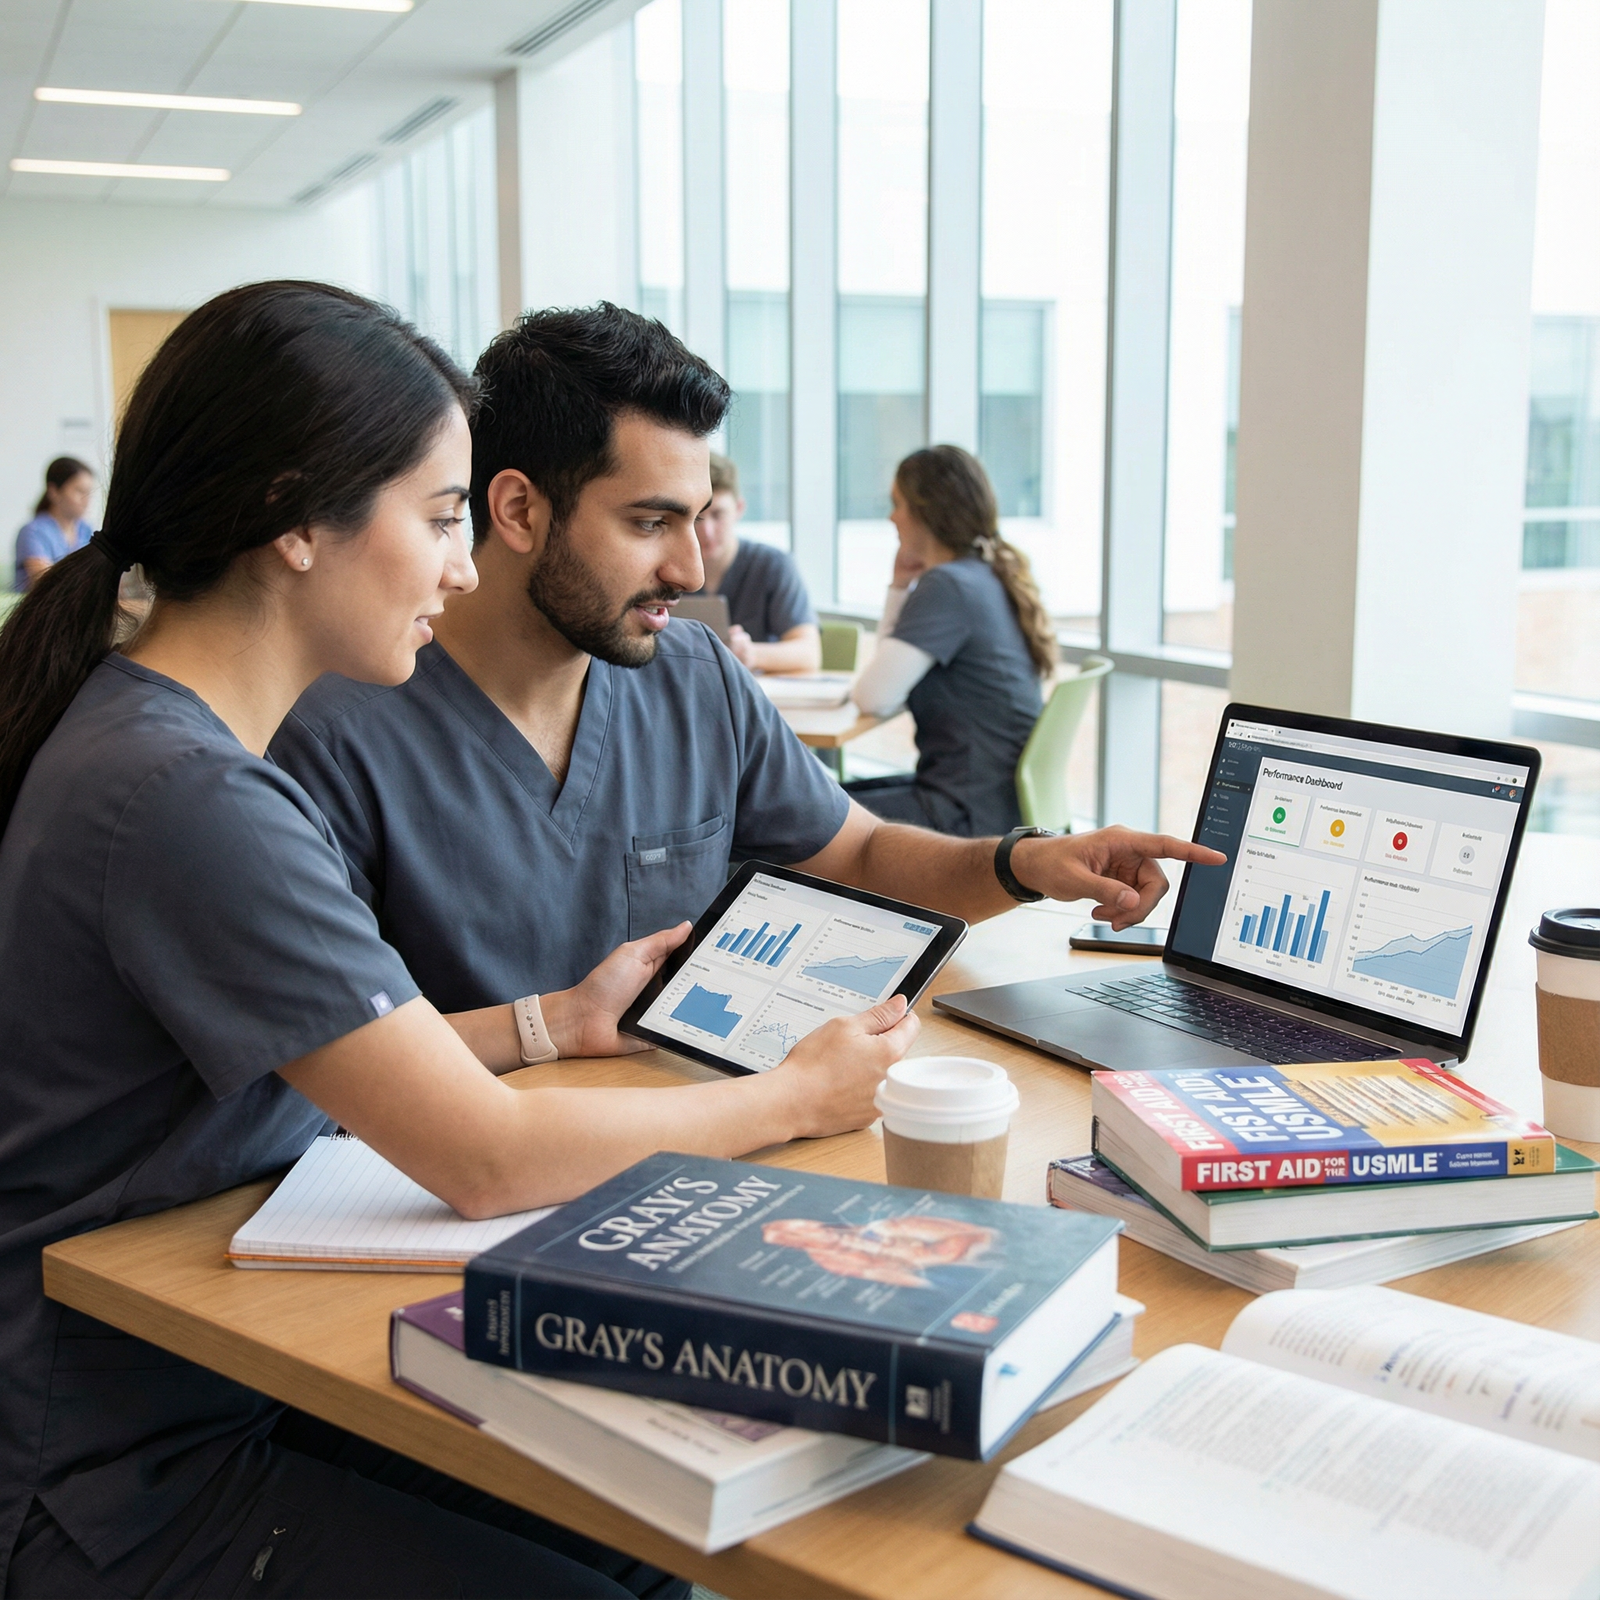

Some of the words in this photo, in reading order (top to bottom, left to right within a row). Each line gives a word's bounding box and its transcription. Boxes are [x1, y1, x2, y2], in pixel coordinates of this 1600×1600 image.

[1129, 1088, 1181, 1110] AID
[1174, 1078, 1238, 1102] AID
[1222, 1074, 1344, 1141] USMLE
[1153, 1112, 1225, 1151] FIRST
[1203, 1103, 1290, 1143] FIST
[1197, 1160, 1271, 1184] FIRST
[1277, 1158, 1321, 1180] AID
[1352, 1152, 1438, 1176] USMLE
[578, 1177, 718, 1251] GRAY'S
[626, 1175, 782, 1271] ANATOMY
[535, 1312, 665, 1370] GRAY'S
[672, 1338, 877, 1410] ANATOMY
